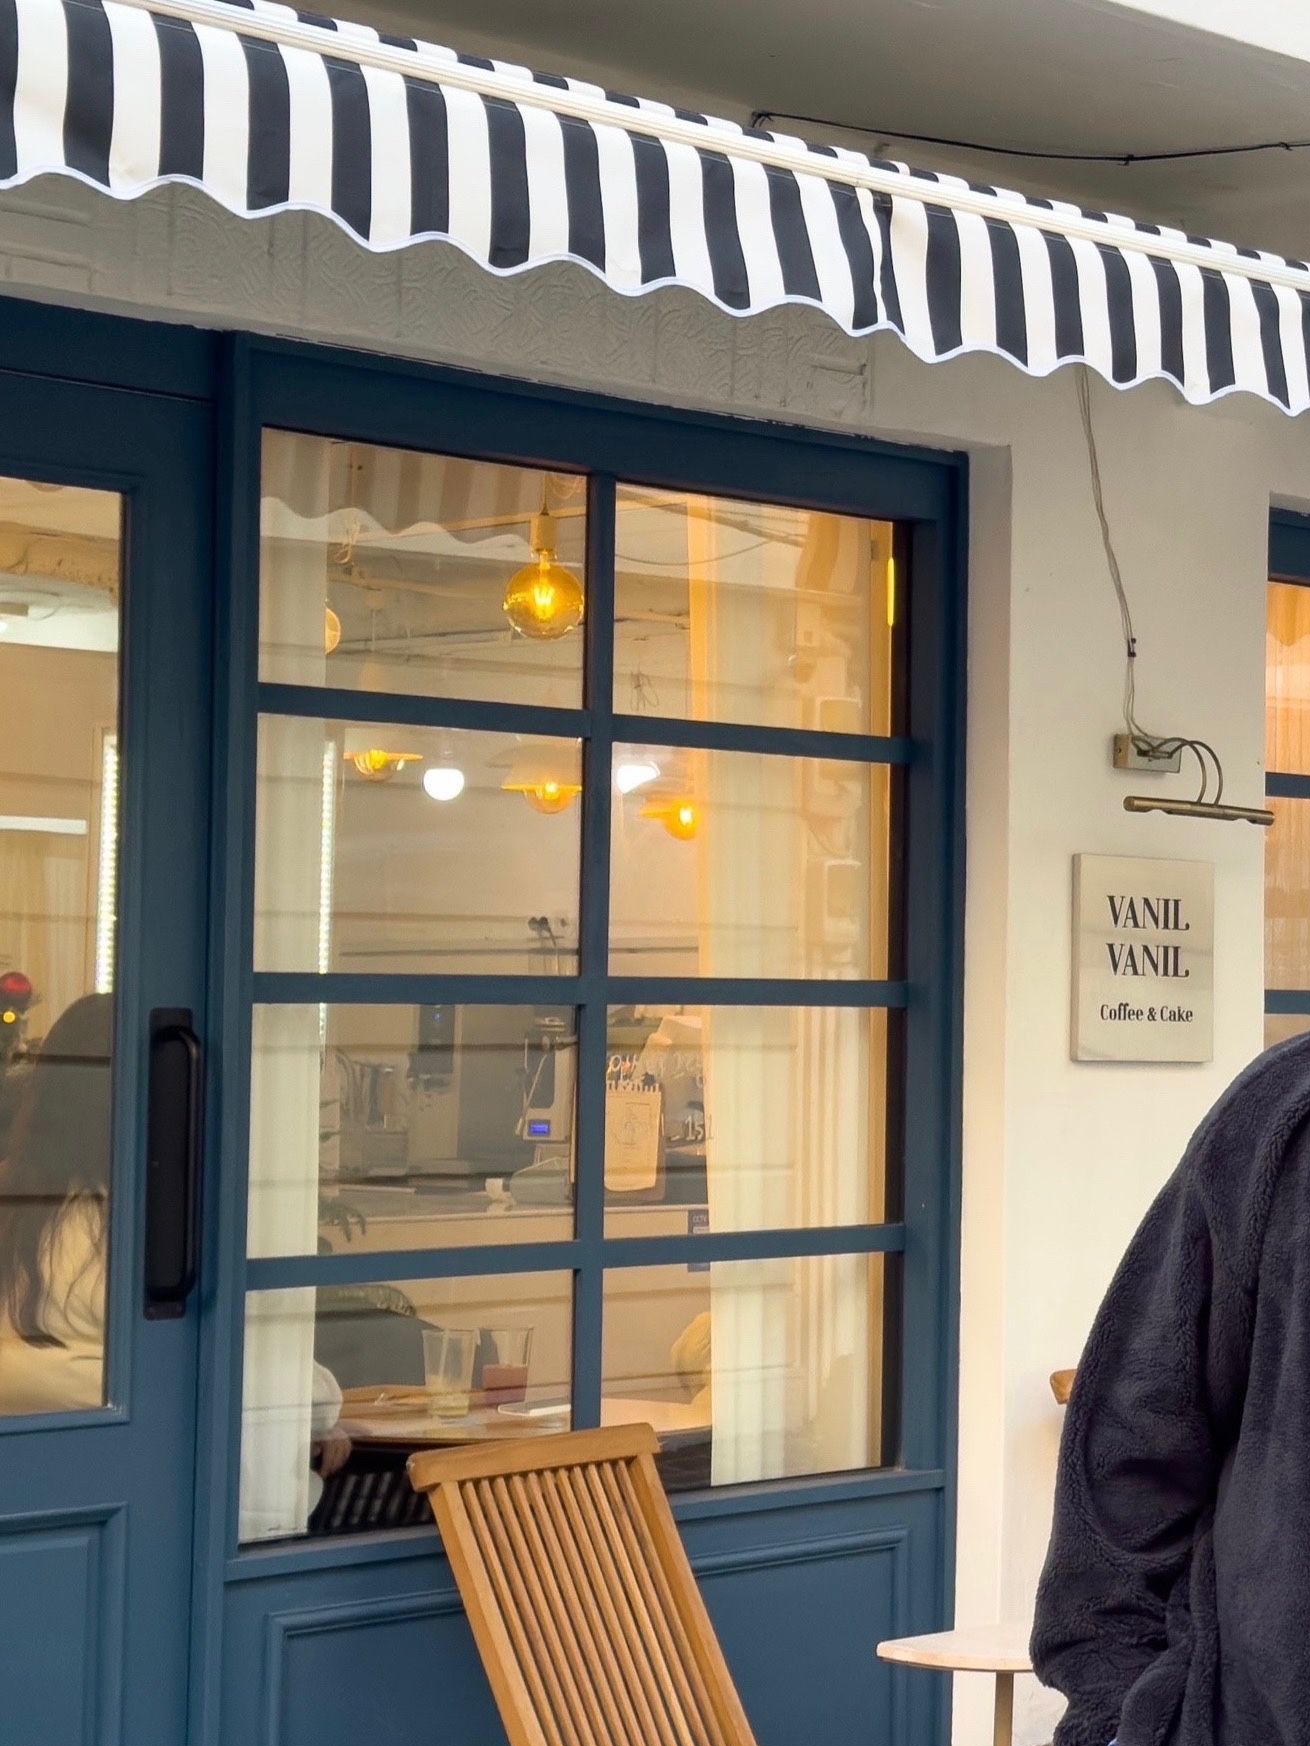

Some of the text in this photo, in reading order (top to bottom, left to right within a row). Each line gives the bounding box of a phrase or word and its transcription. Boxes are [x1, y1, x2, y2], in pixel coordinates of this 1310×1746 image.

[1107, 895, 1190, 931] VANIL
[1106, 943, 1190, 978] VANIL
[1100, 1002, 1193, 1023] Coffee & Cake
